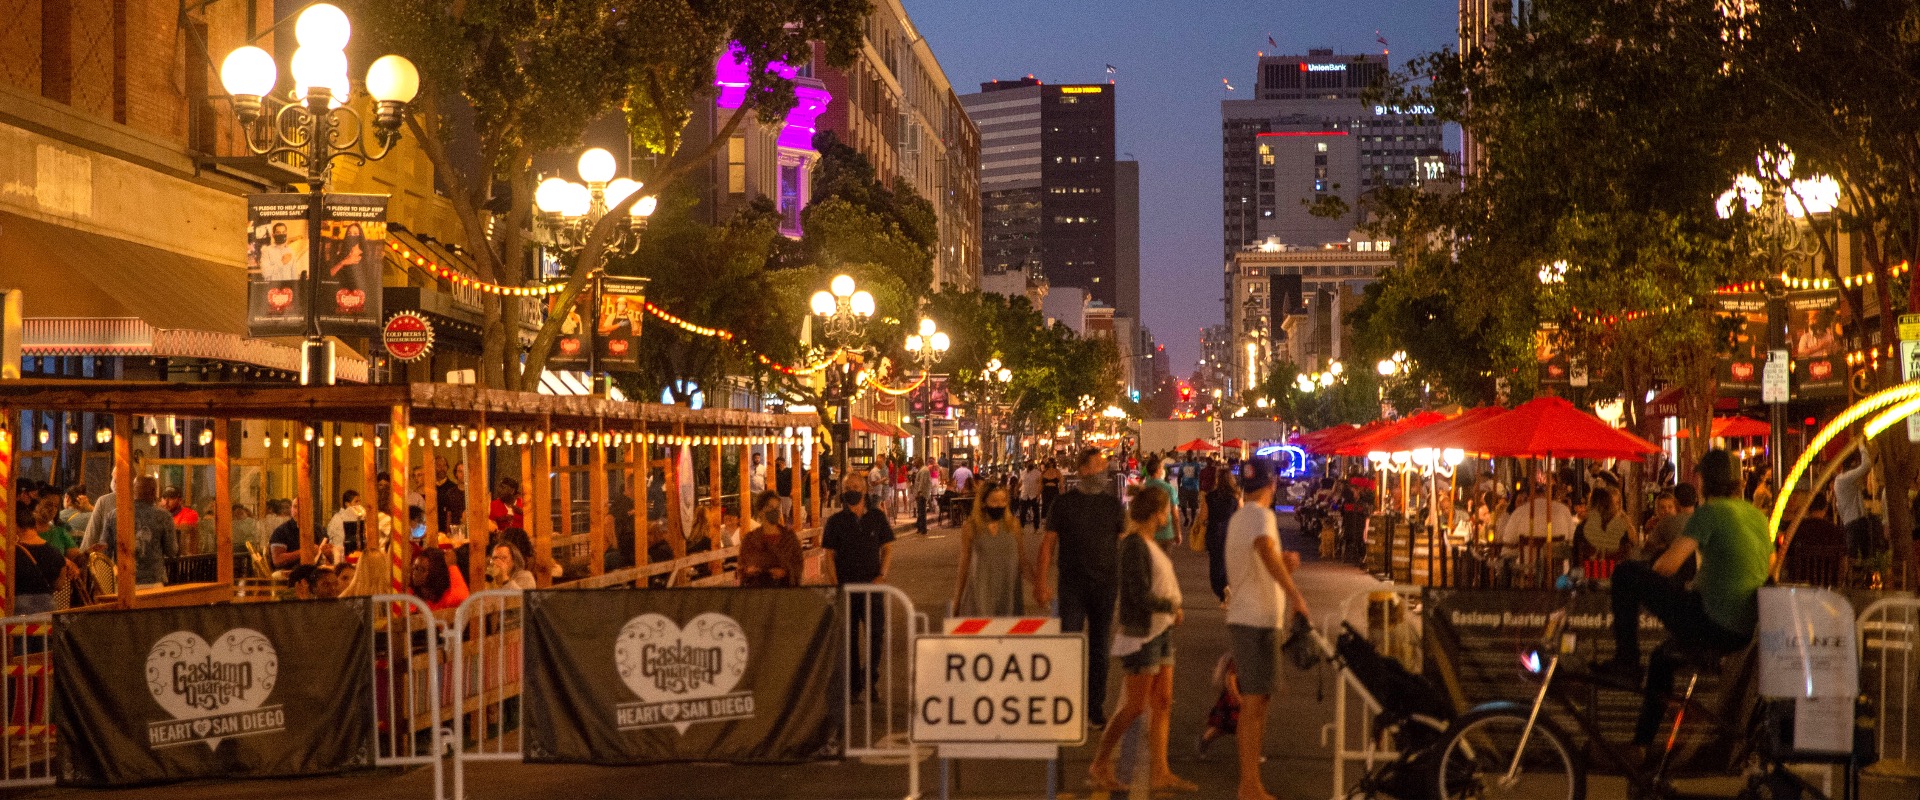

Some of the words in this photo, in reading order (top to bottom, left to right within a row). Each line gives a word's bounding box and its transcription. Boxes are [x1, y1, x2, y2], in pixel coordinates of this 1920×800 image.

[1659, 404, 1677, 414] TAPAS
[1452, 611, 1500, 628] Gaslamp
[1503, 612, 1546, 627] Quarter
[642, 639, 722, 678] Gaslamp
[944, 652, 1052, 682] ROAD
[173, 655, 252, 694] Gaslamp
[655, 668, 714, 694] Quarter
[186, 681, 246, 710] Quarter
[617, 705, 660, 726] HEART
[680, 700, 708, 719] SAN
[712, 696, 755, 716] DIEGO
[922, 696, 1074, 726] CLOSED
[149, 722, 192, 744] HEART
[212, 716, 238, 735] SAN
[242, 710, 284, 730] DIEGO
